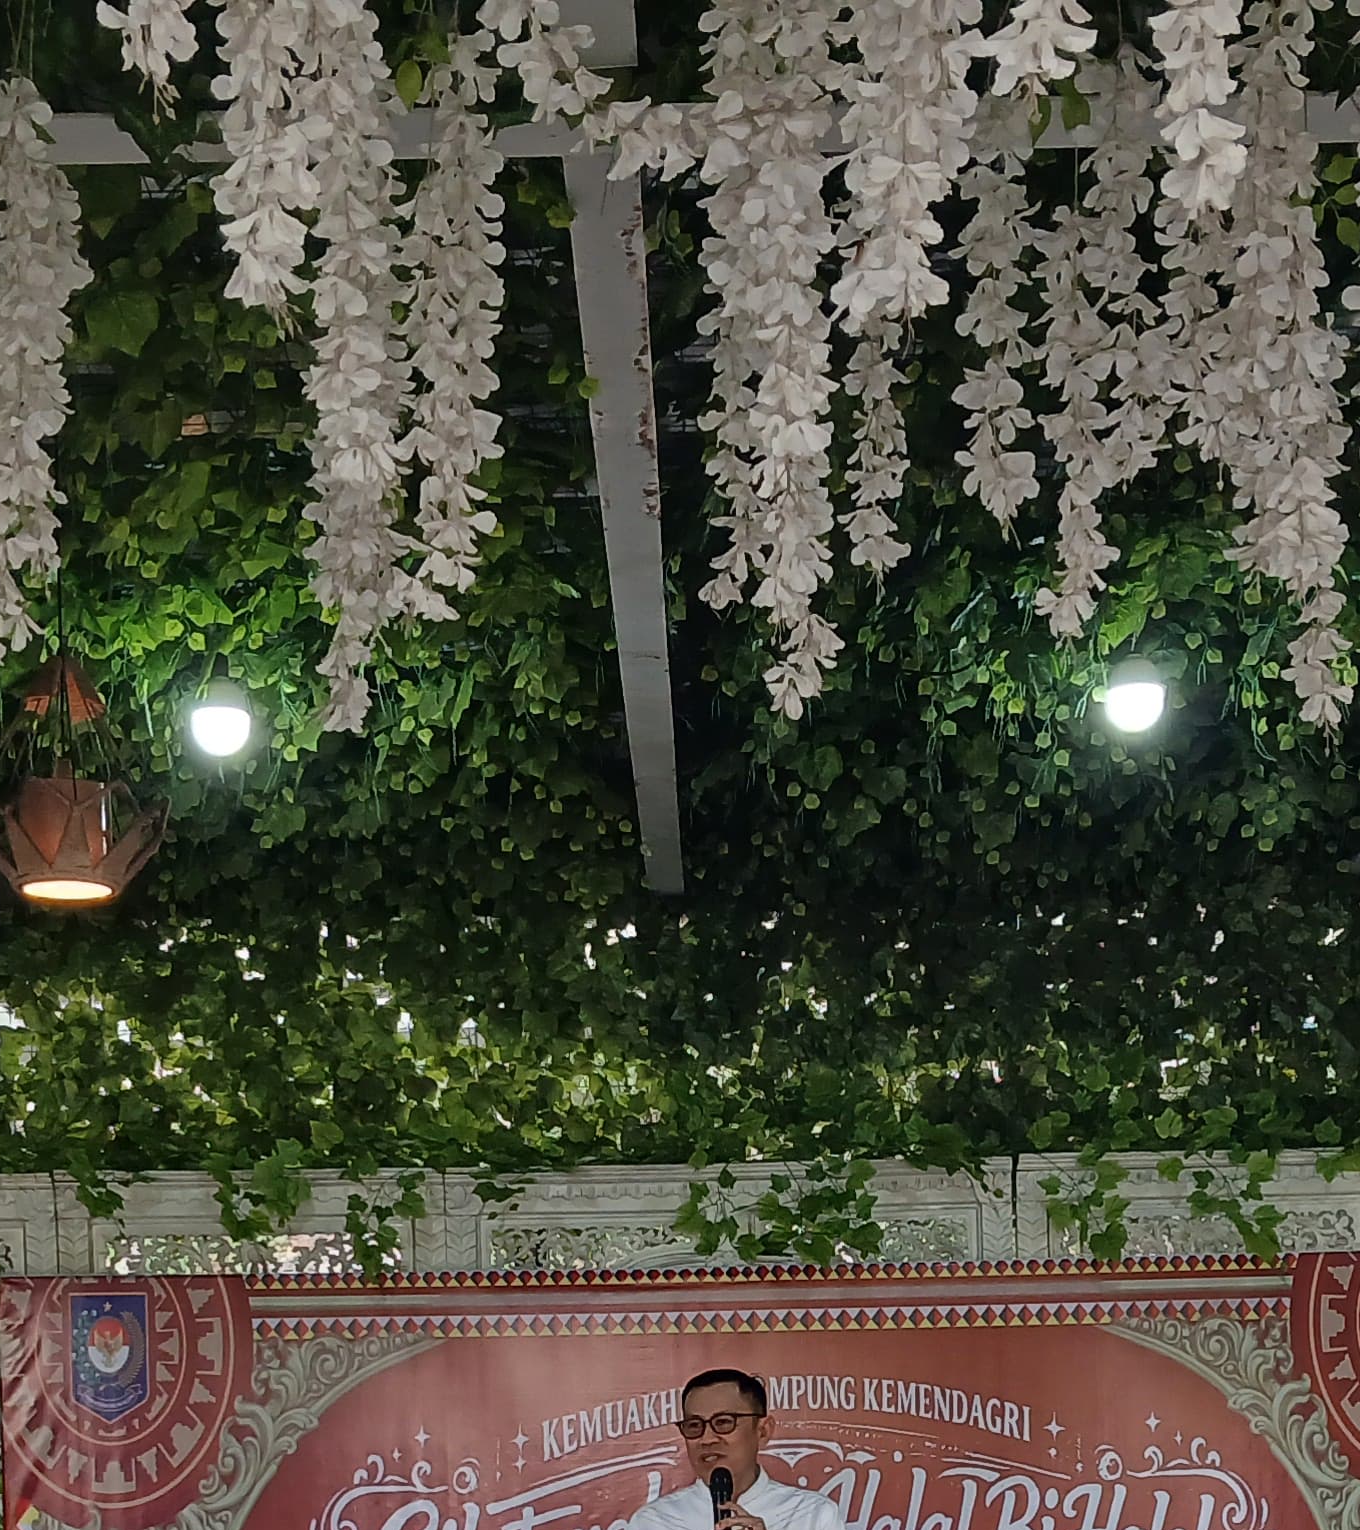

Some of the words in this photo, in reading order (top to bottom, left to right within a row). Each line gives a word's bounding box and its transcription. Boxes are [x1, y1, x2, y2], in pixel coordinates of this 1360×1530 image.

[542, 1386, 684, 1461] KEMUAKHI
[755, 1376, 856, 1411] MPUNG
[863, 1377, 1032, 1441] KEMENDAGRI
